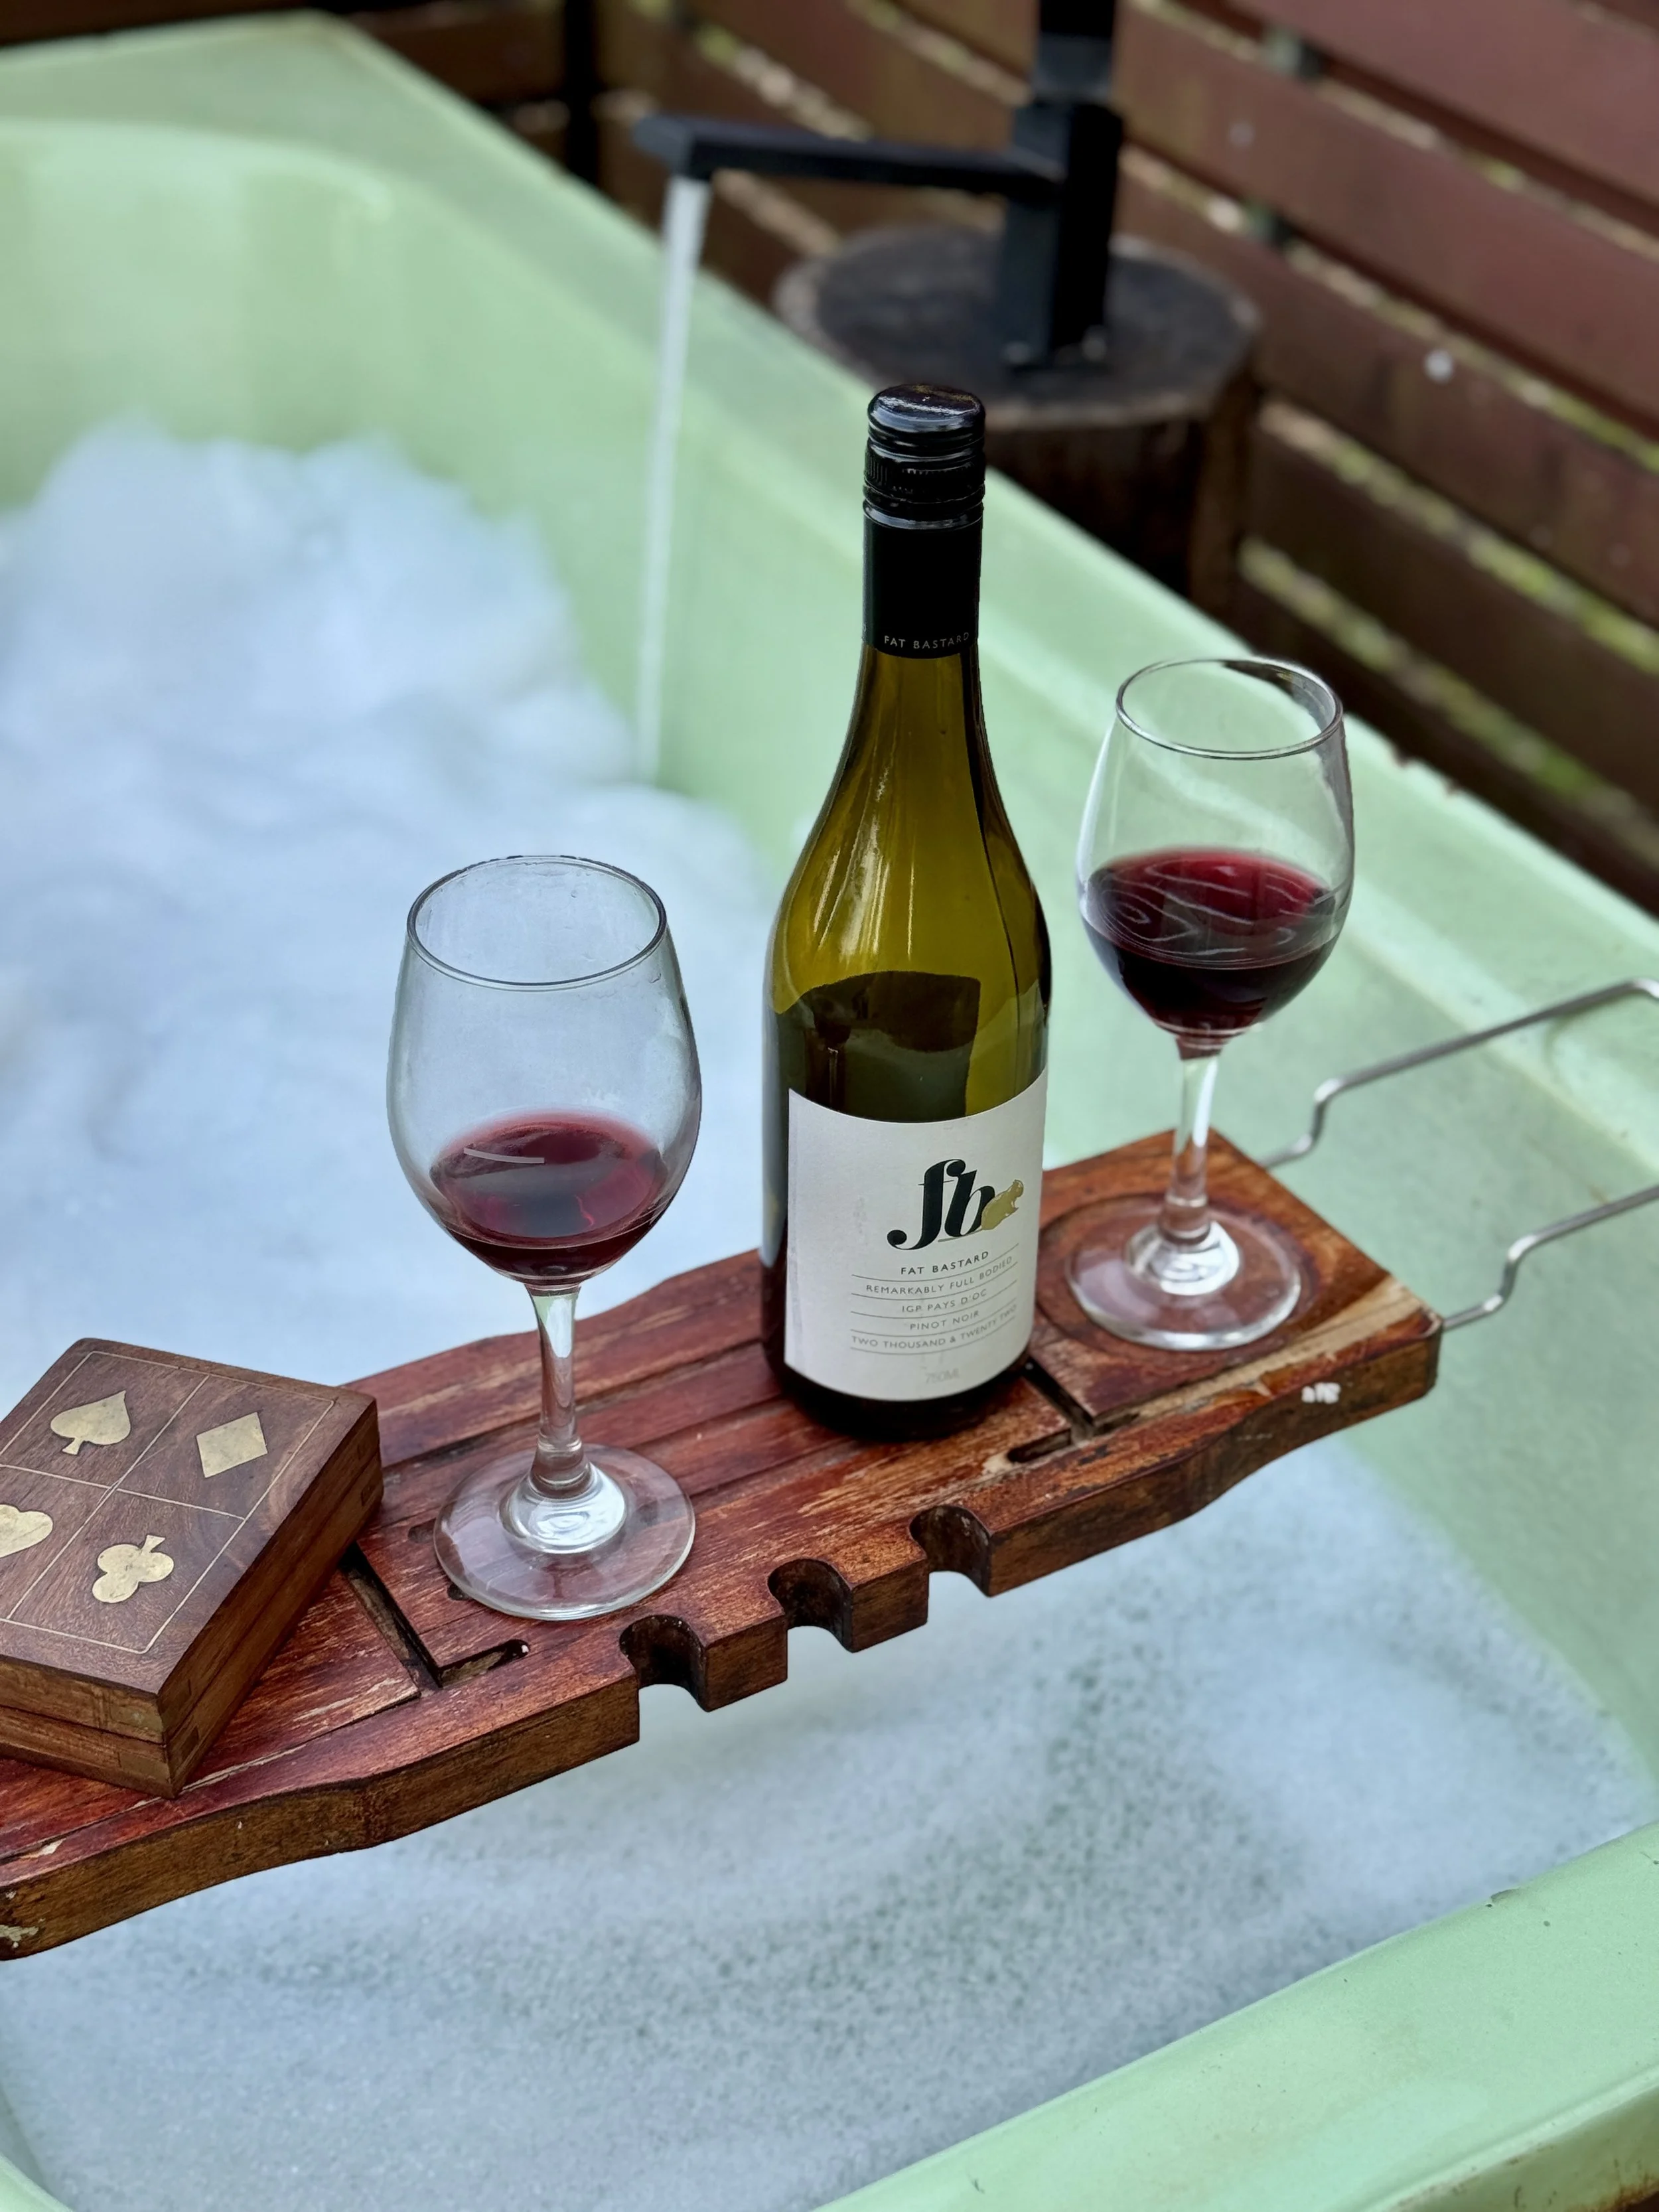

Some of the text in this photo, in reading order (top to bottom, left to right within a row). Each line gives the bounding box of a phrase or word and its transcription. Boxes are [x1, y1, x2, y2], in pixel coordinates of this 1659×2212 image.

[884, 632, 970, 649] FAT BASTARD
[901, 1251, 989, 1275] FAT BASTARD
[866, 1256, 1013, 1294] REMARKABLY FULL BODIED
[927, 1300, 956, 1311] PAYS
[960, 1288, 987, 1305] D'OC
[851, 1335, 878, 1347] TWO
[883, 1338, 946, 1349] THOUSAND
[961, 1319, 996, 1340] TWENTY
[999, 1303, 1017, 1319] TWO
[910, 1310, 979, 1330] PINOT NOIR
